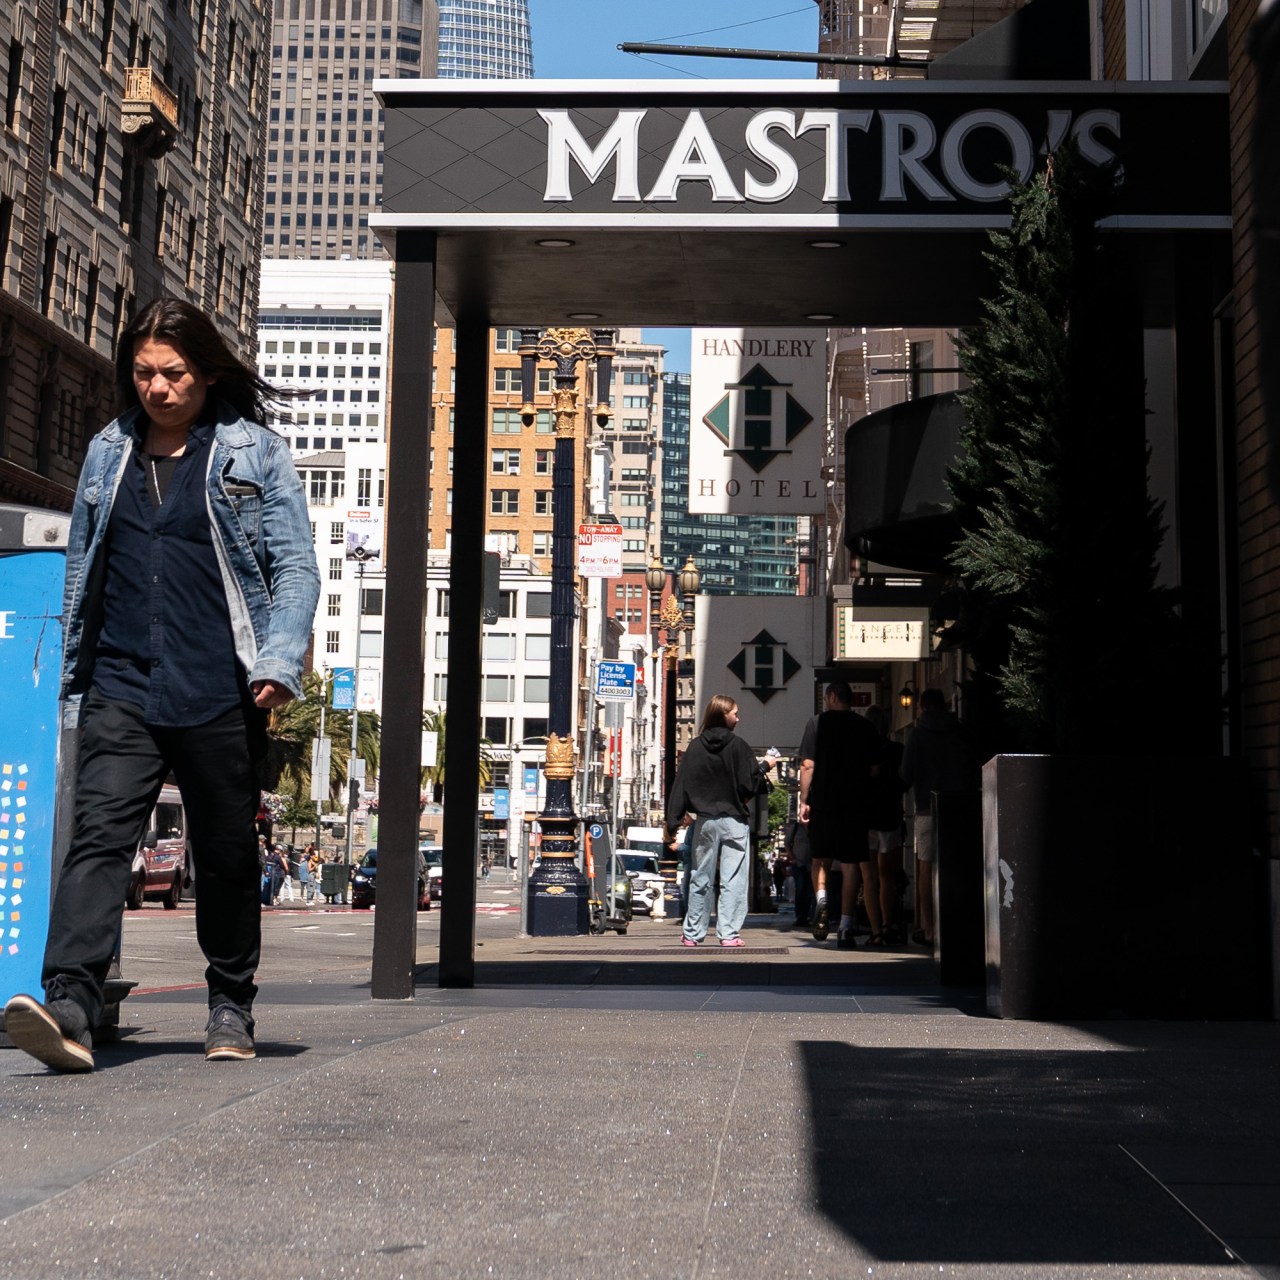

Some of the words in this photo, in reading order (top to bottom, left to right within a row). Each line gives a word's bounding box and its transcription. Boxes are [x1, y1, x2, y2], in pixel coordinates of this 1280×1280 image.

[535, 107, 1124, 203] MASTRO'S
[701, 338, 816, 358] HANDLERY
[697, 479, 818, 498] HOTEL
[579, 534, 592, 544] NO
[593, 535, 621, 543] STOPPING
[600, 664, 614, 672] Pay
[615, 664, 625, 673] by
[600, 671, 627, 679] License
[600, 678, 618, 686] Plate
